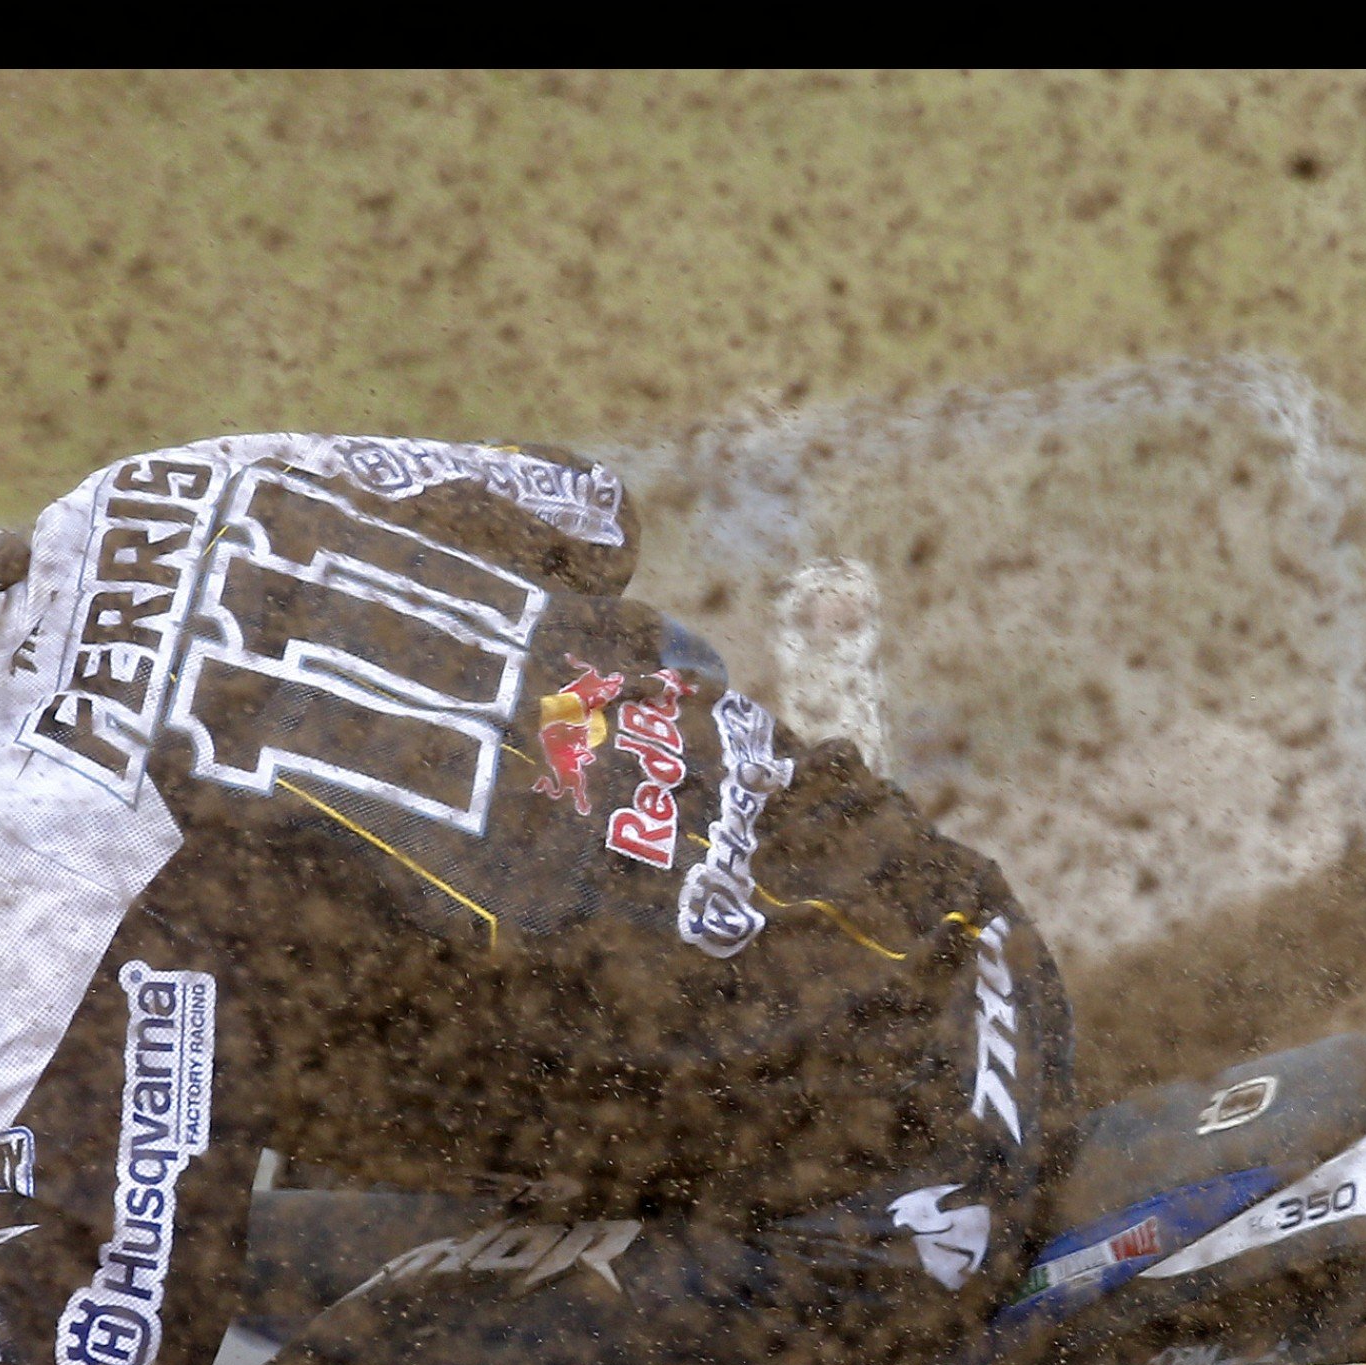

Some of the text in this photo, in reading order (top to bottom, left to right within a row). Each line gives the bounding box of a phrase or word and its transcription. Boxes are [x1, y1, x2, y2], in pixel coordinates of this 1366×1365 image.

[32, 457, 214, 784] FERRIS
[165, 463, 548, 837] 111
[104, 980, 179, 1300] Husqvarna
[185, 983, 207, 1146] FACTORY RACING
[1276, 1182, 1357, 1231] 350
